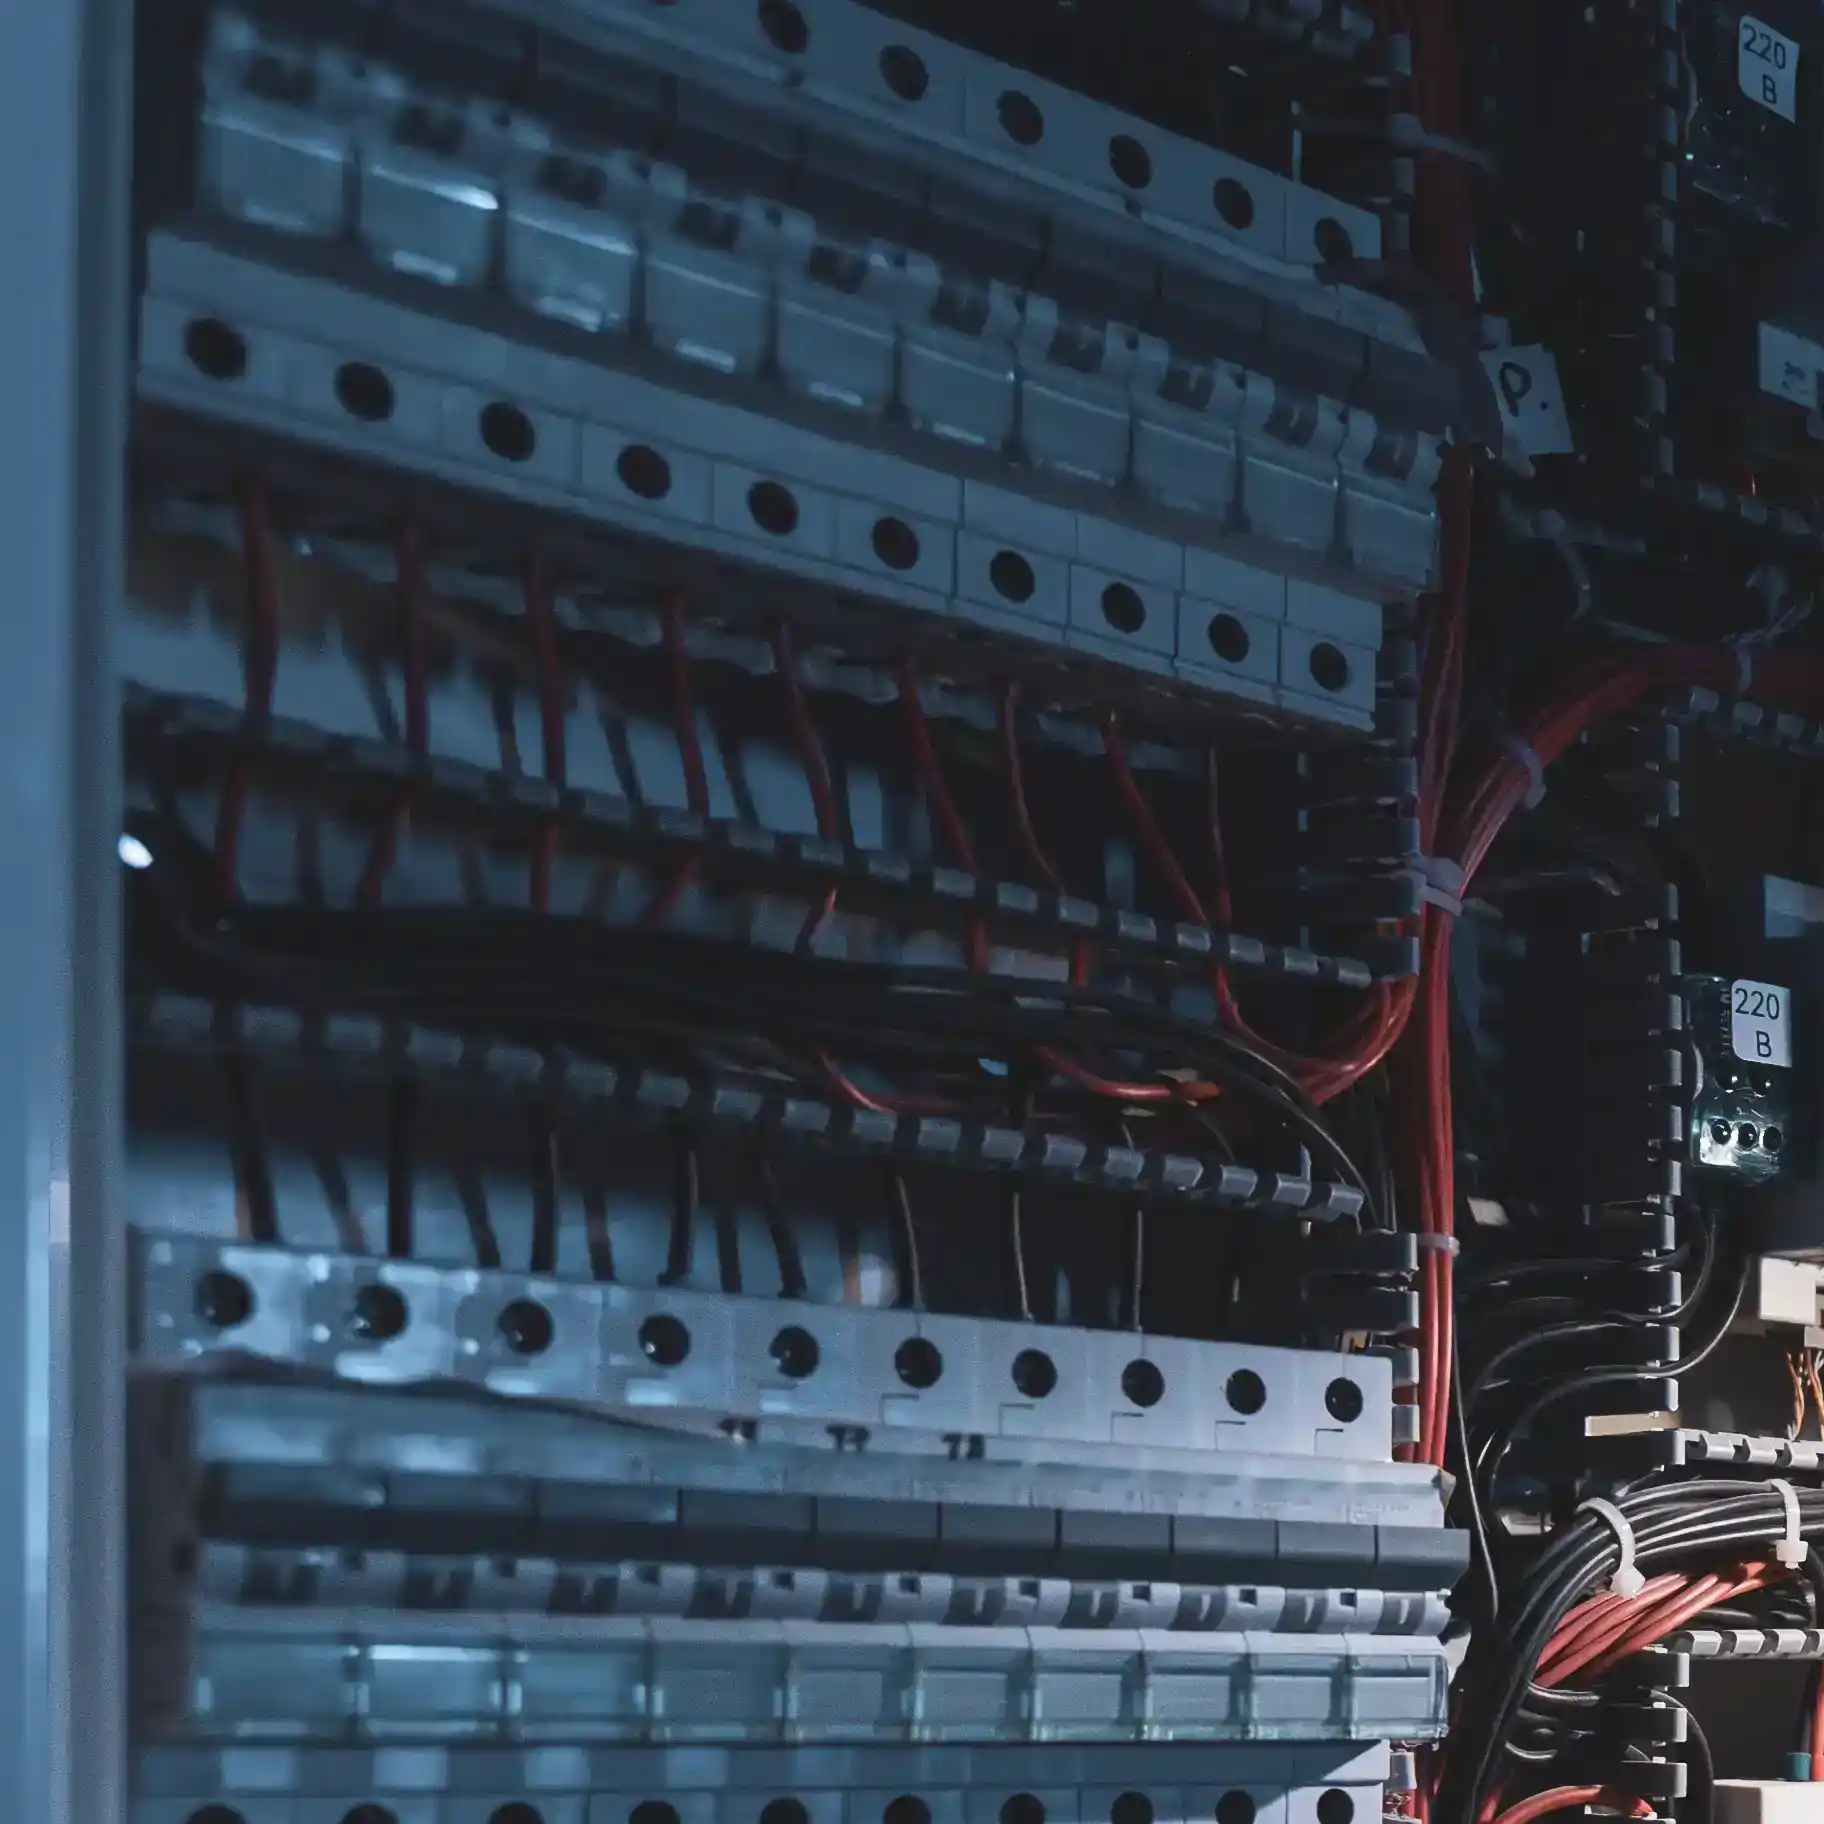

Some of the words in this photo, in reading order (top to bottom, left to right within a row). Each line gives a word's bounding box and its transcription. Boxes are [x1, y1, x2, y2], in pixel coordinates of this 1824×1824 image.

[1741, 23, 1787, 71] 220
[1762, 73, 1778, 105] B
[1734, 987, 1780, 1020] 220
[1755, 1030, 1772, 1058] B
